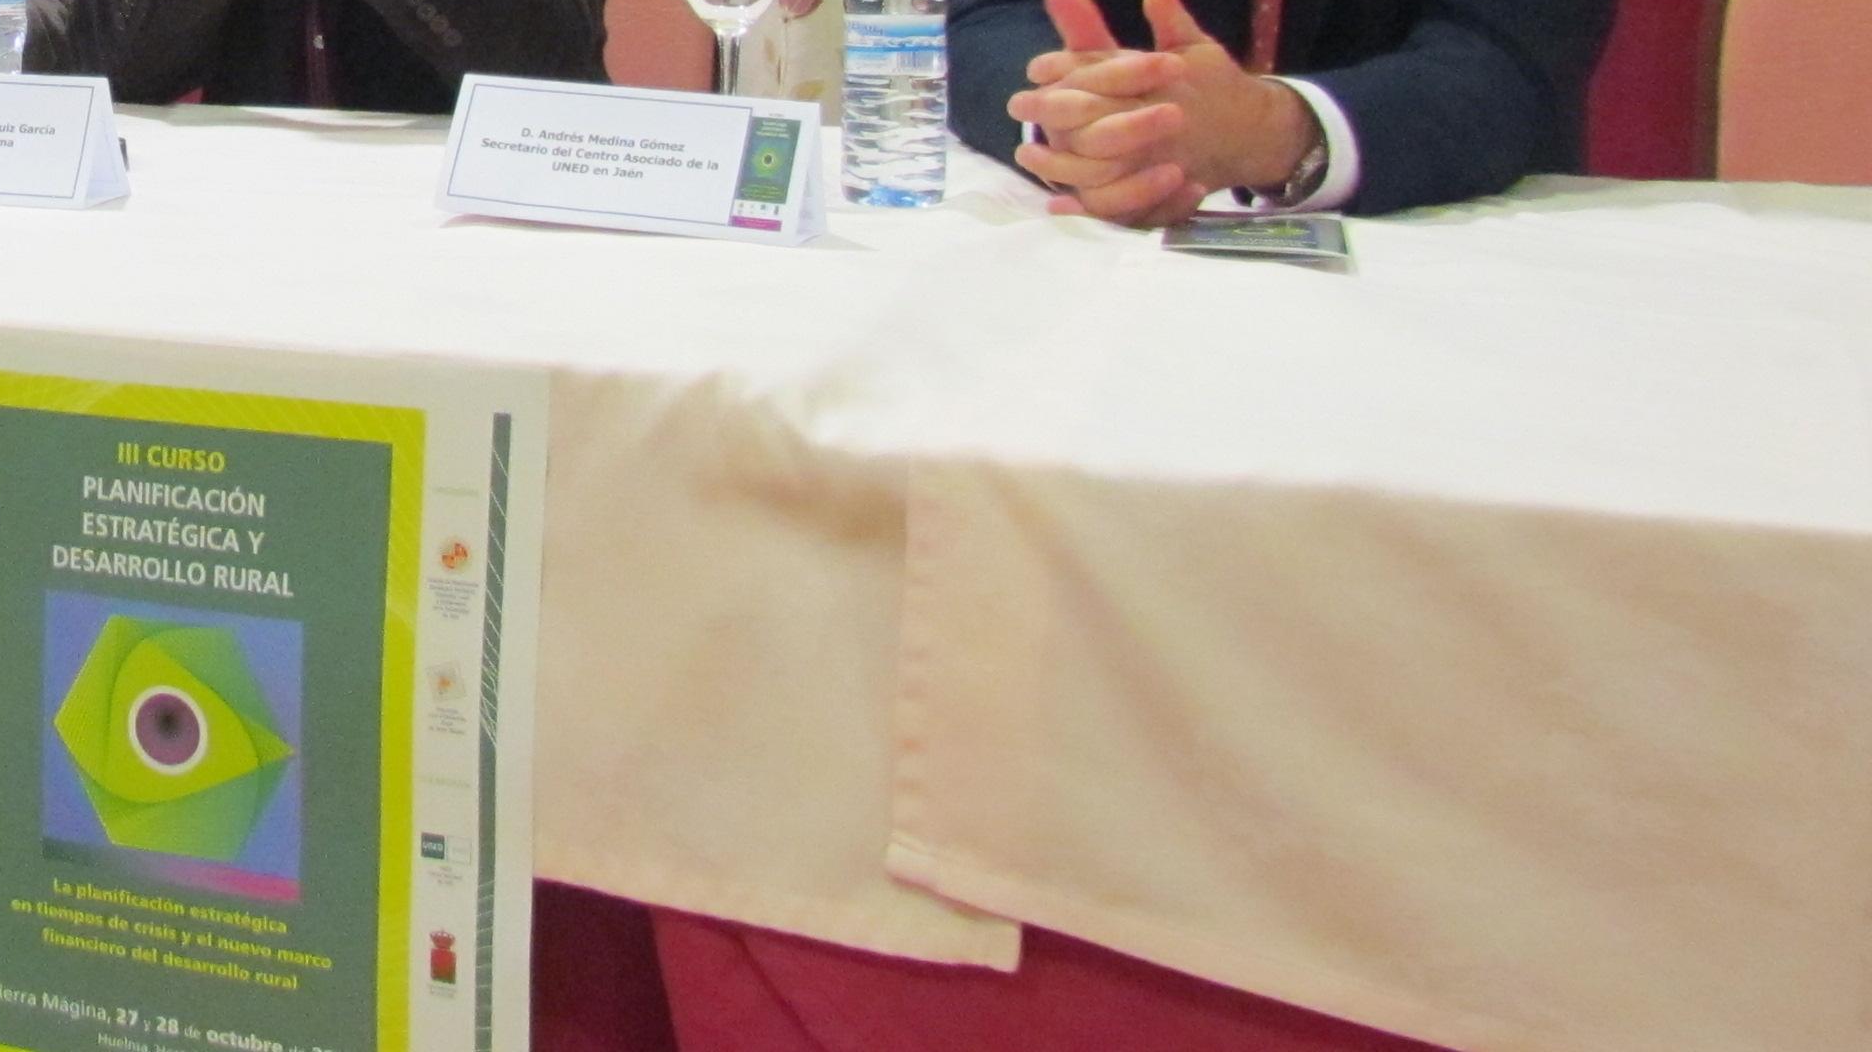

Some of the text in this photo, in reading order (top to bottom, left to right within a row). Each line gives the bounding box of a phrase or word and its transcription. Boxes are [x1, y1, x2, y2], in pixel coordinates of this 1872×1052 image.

[481, 137, 719, 171] Secretario del Centro Asociado de la
[521, 127, 686, 153] D. Andrés Medina Gómez
[551, 161, 644, 179] UNED en Jaén
[118, 442, 225, 473] III CURSO
[83, 475, 265, 518] PLANIFICACIÓN
[82, 512, 265, 555] ESTRATÉGICA Y
[52, 544, 294, 597] DESARROLLO RURAL
[53, 877, 288, 935] La planificación estratégica
[10, 898, 332, 971] en tiempos de crisis y el nuevo marco
[41, 926, 299, 990] financiero del desarrollo rural
[41, 991, 112, 1025] Mágina,
[116, 1006, 139, 1027] 27
[143, 1017, 151, 1032] y
[156, 1015, 179, 1035] 28
[183, 1023, 201, 1040] de
[206, 1029, 284, 1052] octubre
